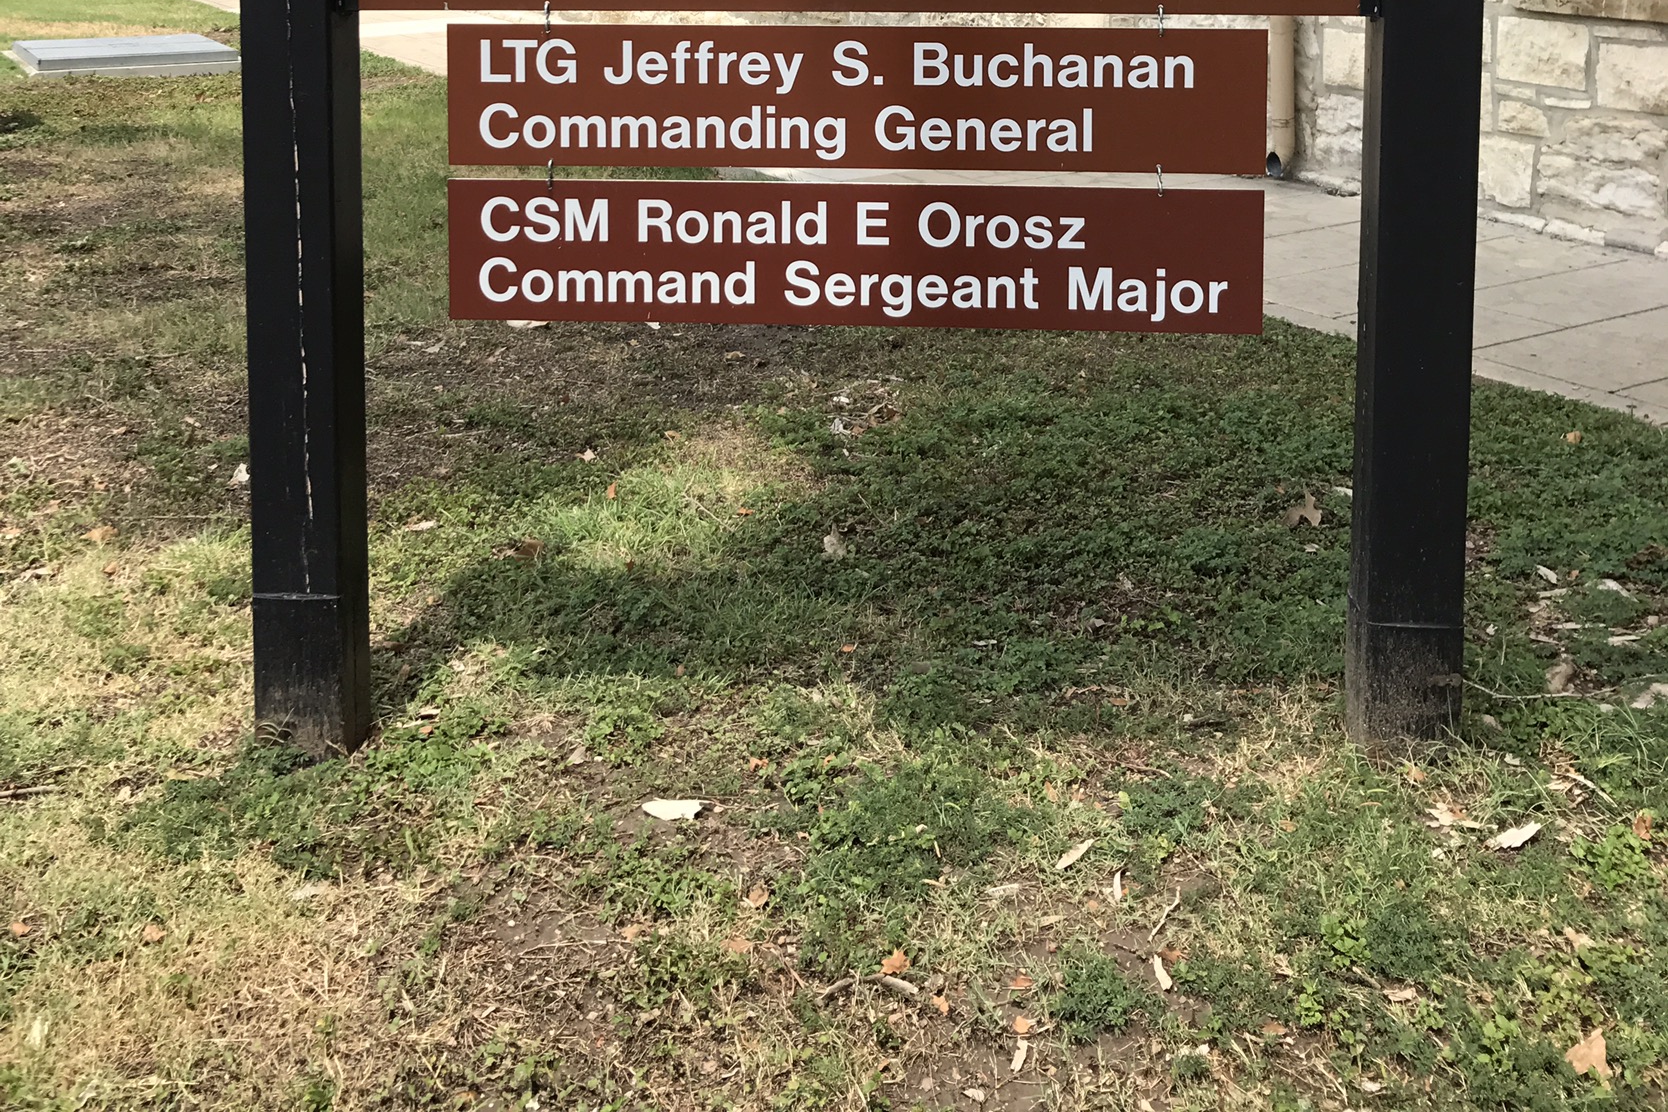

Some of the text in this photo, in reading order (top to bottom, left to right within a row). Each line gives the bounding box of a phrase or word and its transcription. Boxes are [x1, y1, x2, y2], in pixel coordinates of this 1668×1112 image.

[480, 38, 1194, 95] LTG Jeffrey S. Buchanan
[479, 102, 1093, 161] Commanding General
[480, 196, 1086, 250] CSM Ronald E Orosz
[478, 256, 1228, 322] Command Sergeant Major
